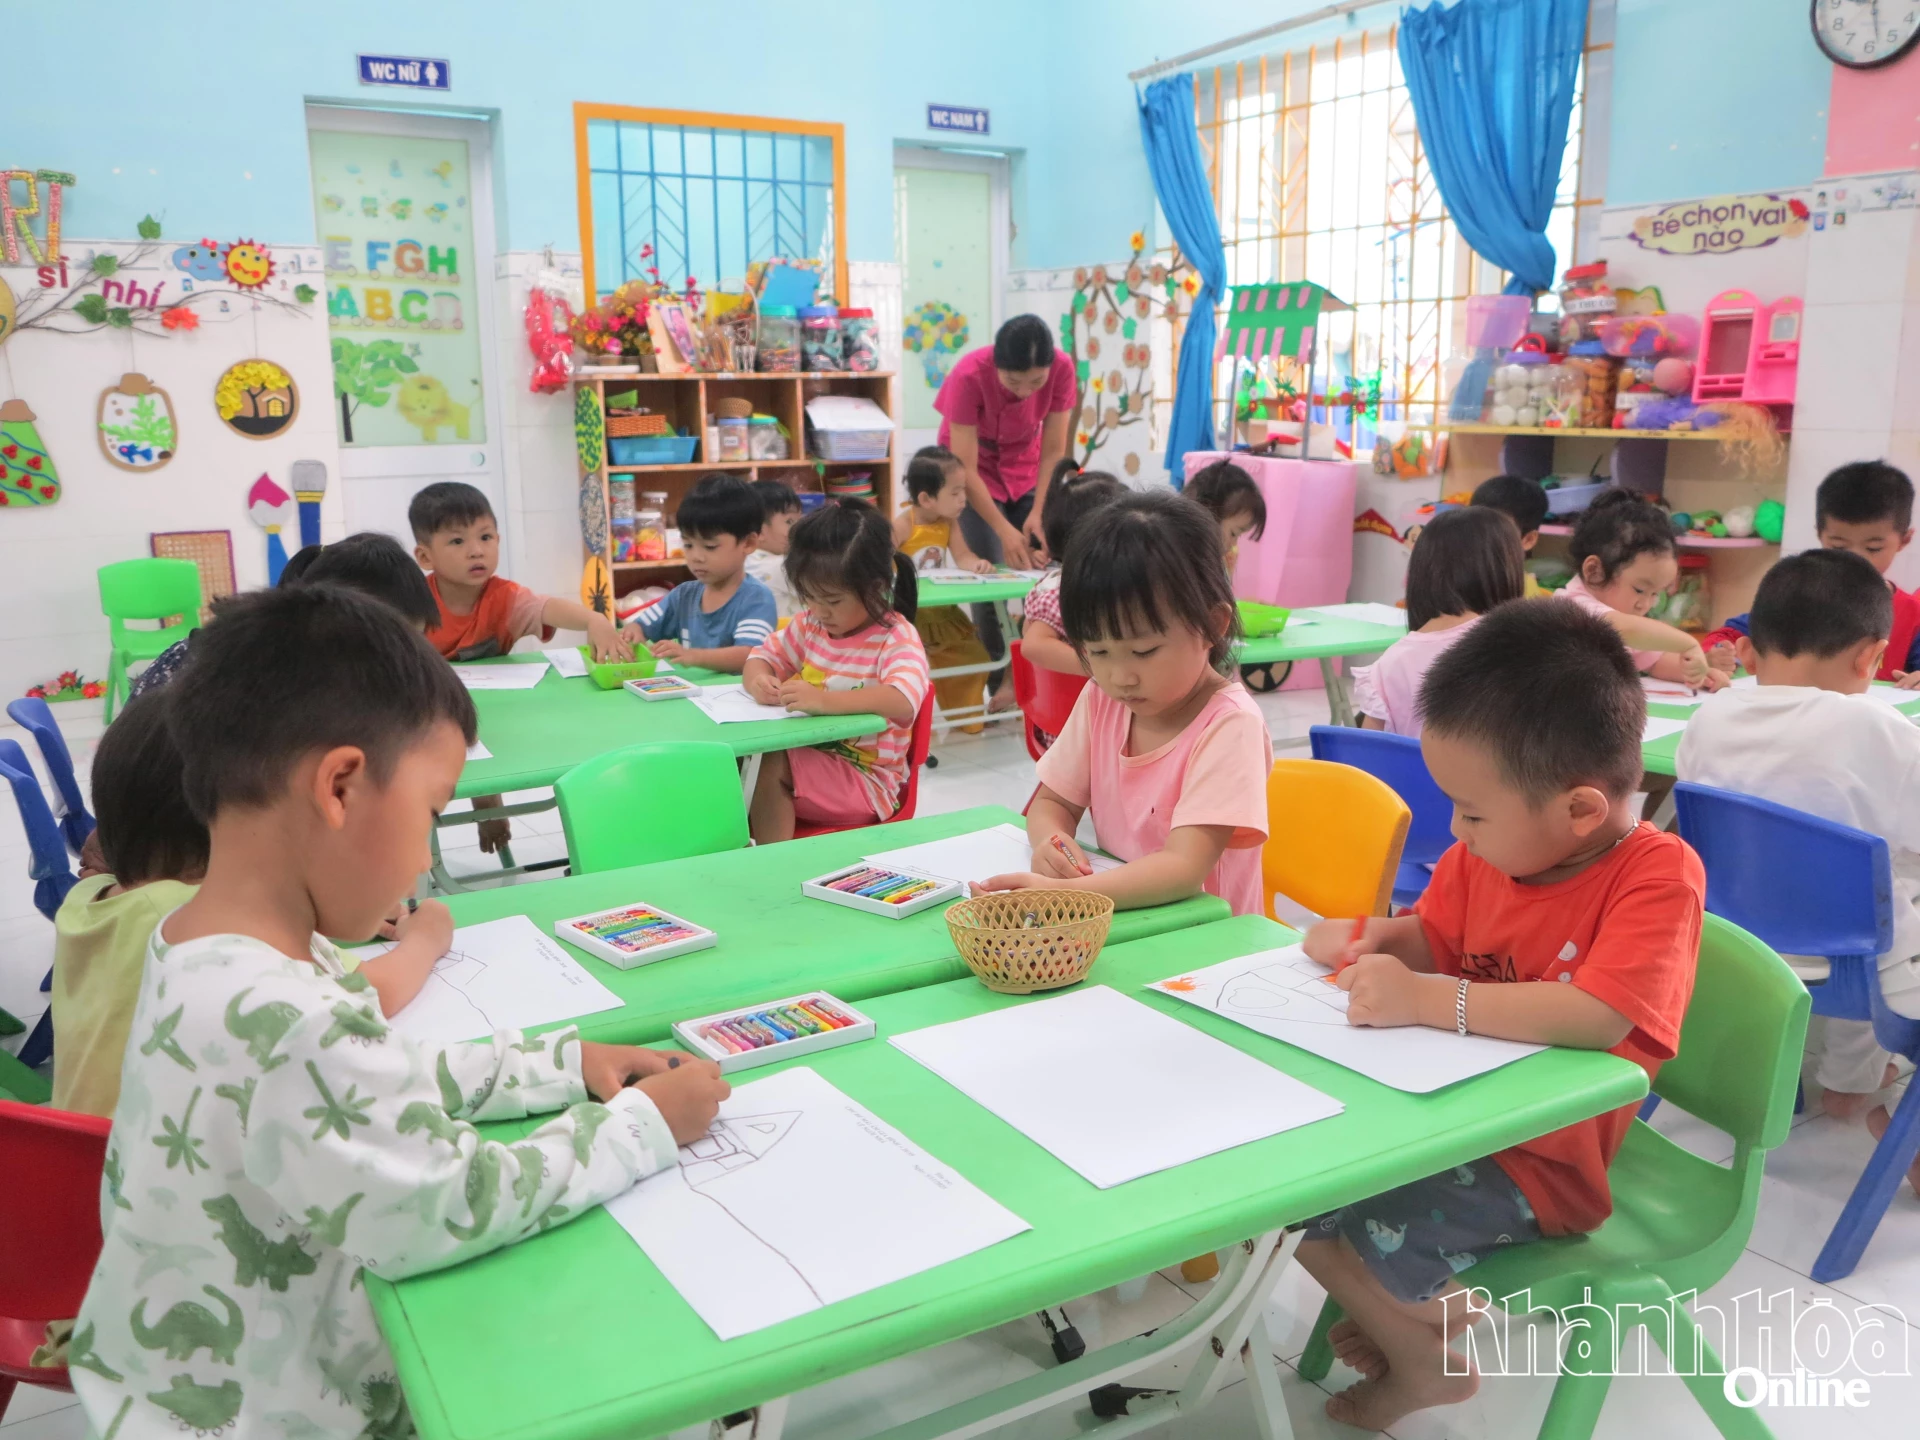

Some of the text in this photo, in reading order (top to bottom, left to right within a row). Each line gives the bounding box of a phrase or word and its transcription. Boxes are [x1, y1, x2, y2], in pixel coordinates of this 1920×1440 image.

[1832, 18, 1844, 31] 8
[1903, 11, 1915, 24] 4
[1845, 32, 1856, 46] 7
[1886, 30, 1898, 42] 5
[1863, 41, 1875, 54] 6
[368, 61, 421, 82] WC NỮ
[931, 110, 974, 128] WC NAM
[0, 168, 76, 265] RT
[1652, 203, 1786, 238] Bé chọn vai
[1693, 225, 1744, 248] nào
[102, 279, 166, 312] nhí
